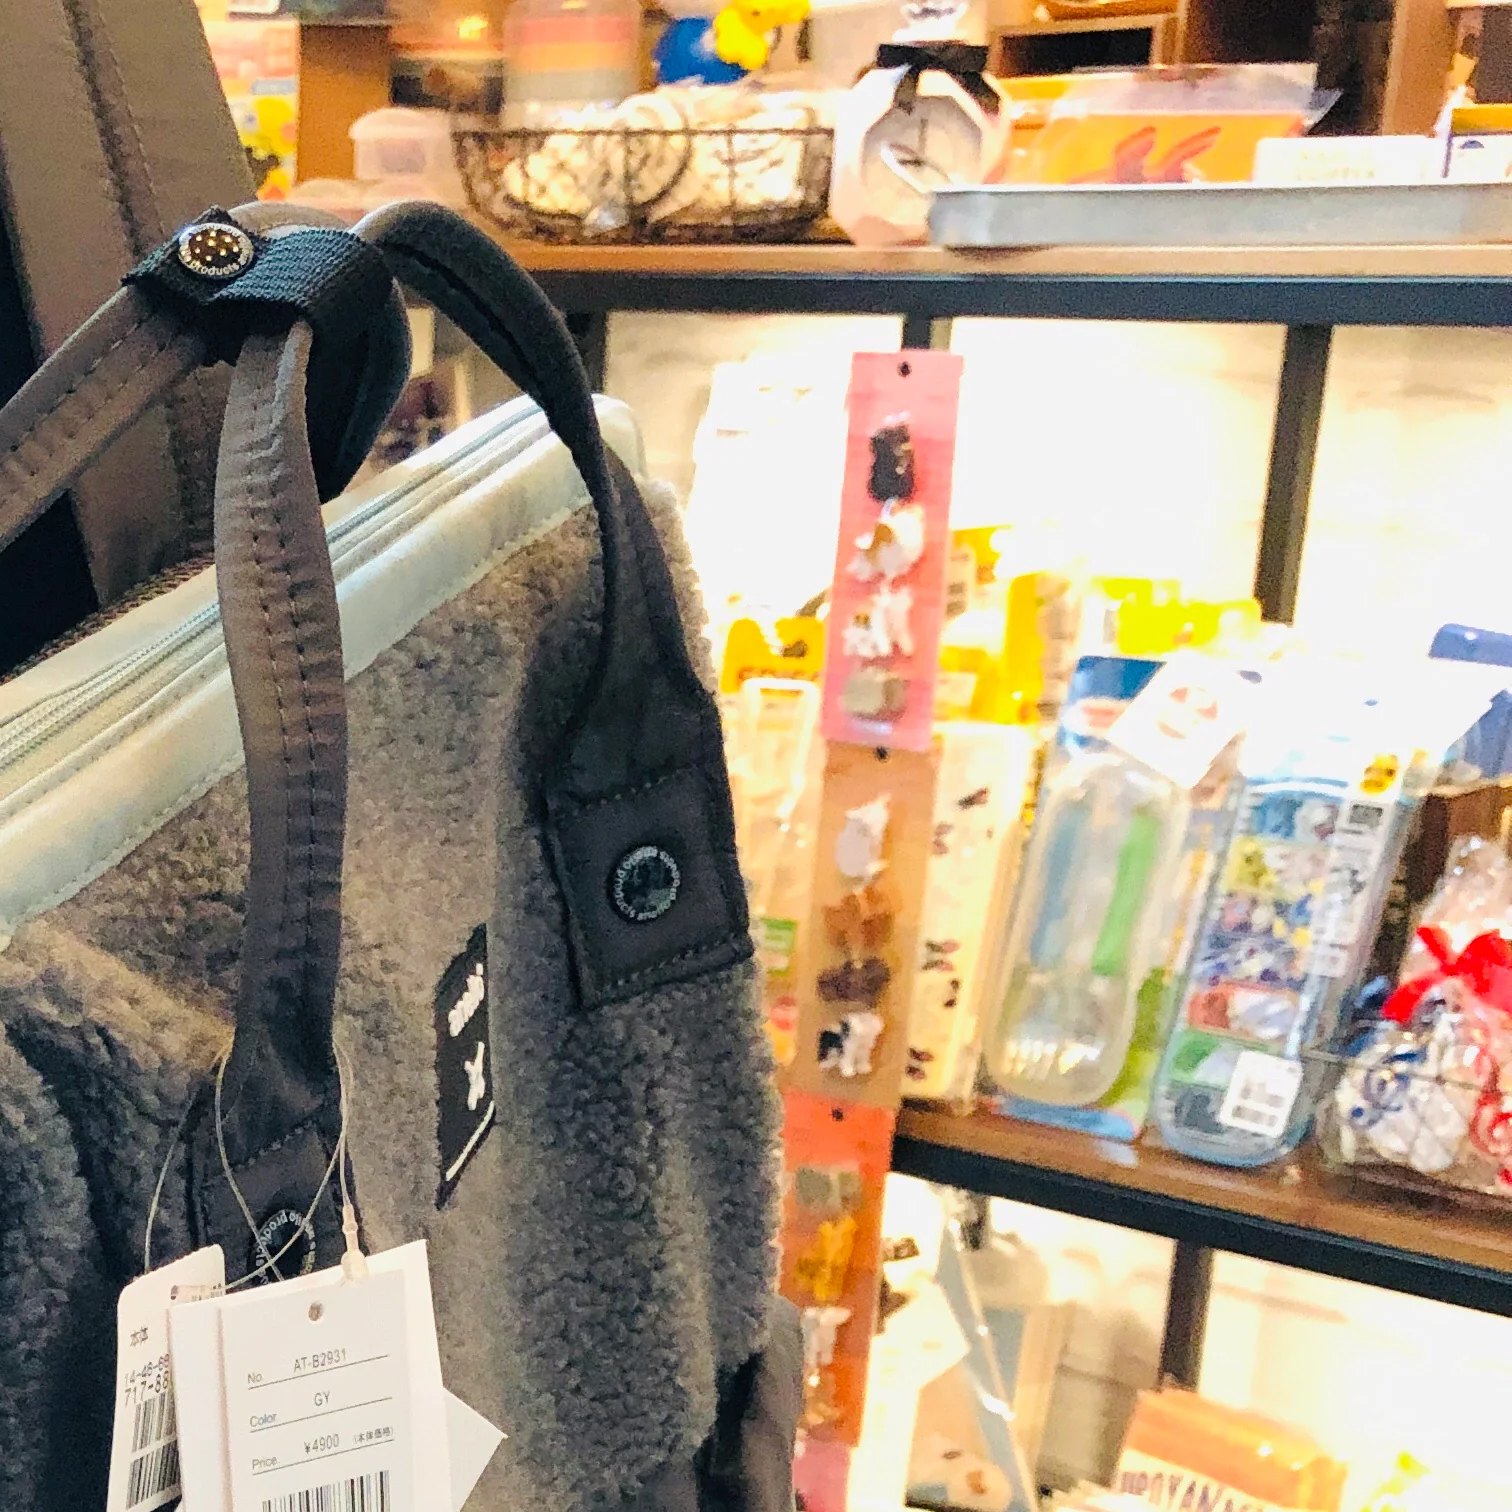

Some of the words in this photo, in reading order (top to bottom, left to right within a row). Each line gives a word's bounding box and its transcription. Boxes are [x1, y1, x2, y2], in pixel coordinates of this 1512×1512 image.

[293, 1348, 347, 1372] AT-B2931
[249, 1412, 277, 1428] Color
[314, 1391, 331, 1407] GY
